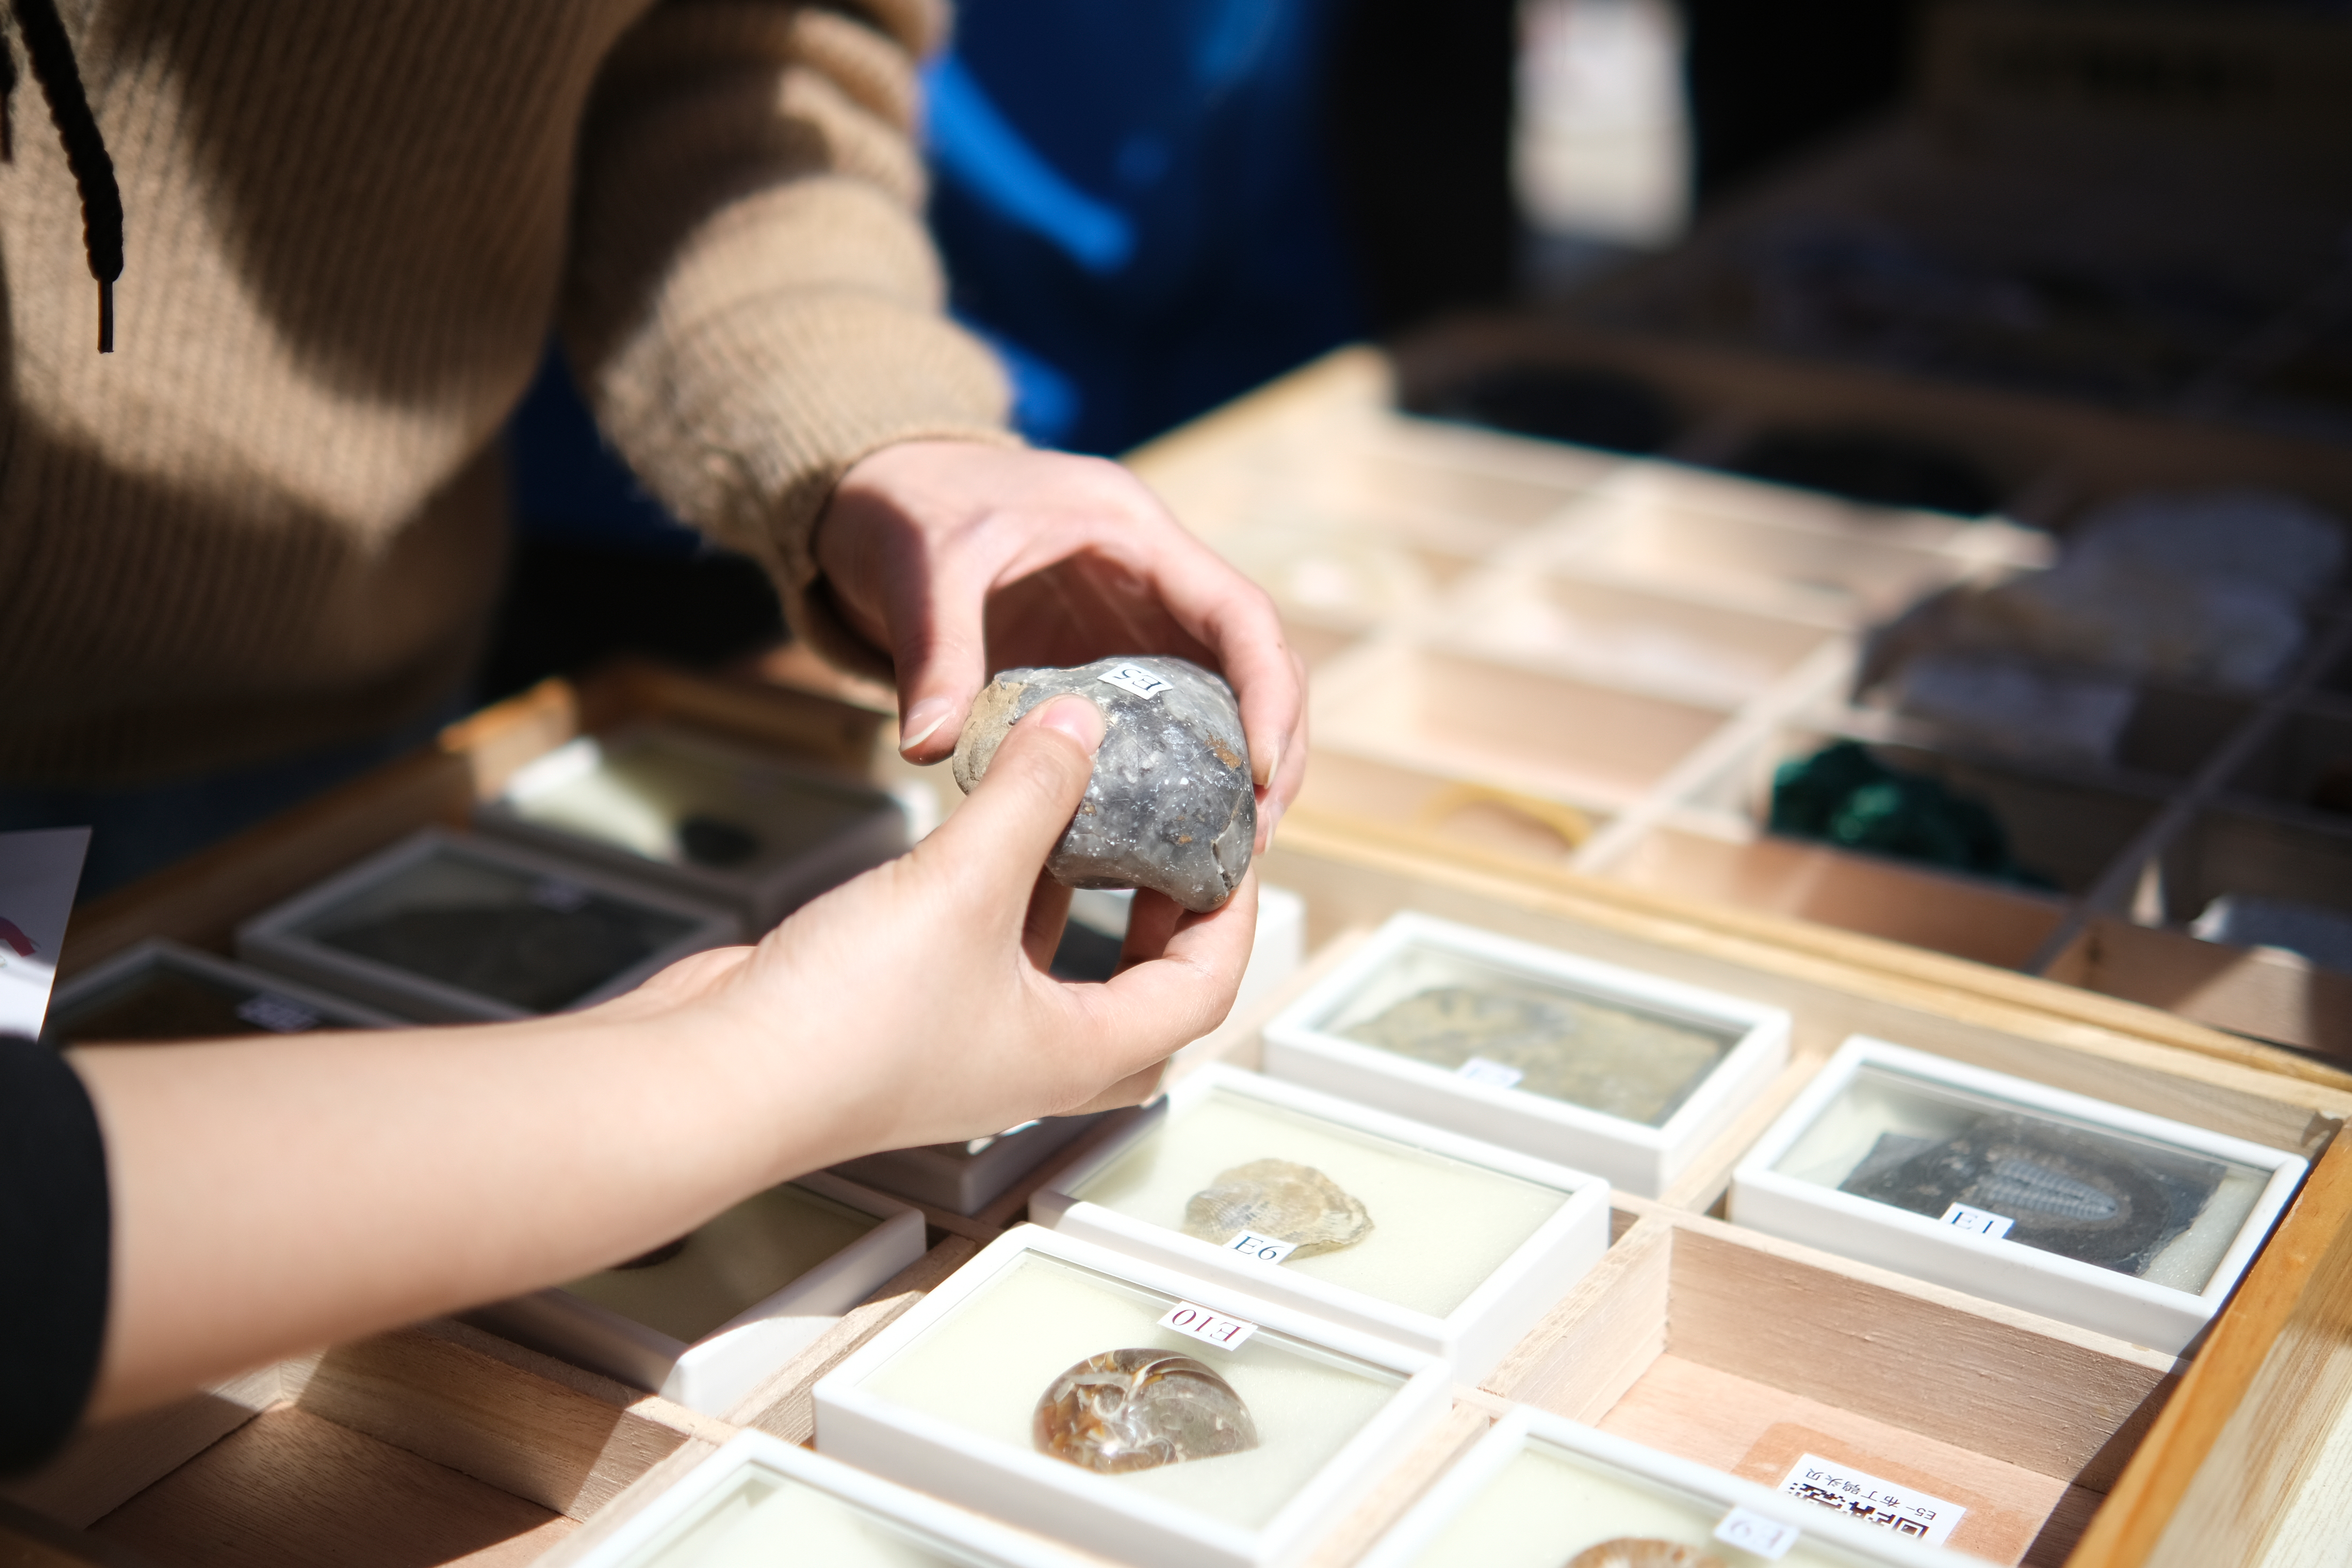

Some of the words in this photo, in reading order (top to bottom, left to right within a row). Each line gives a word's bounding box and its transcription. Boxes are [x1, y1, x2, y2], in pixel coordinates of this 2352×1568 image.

[1112, 669, 1165, 693] E5
[1951, 1211, 1995, 1234] E1
[1230, 1235, 1285, 1260] E6
[1172, 1309, 1245, 1344] E10
